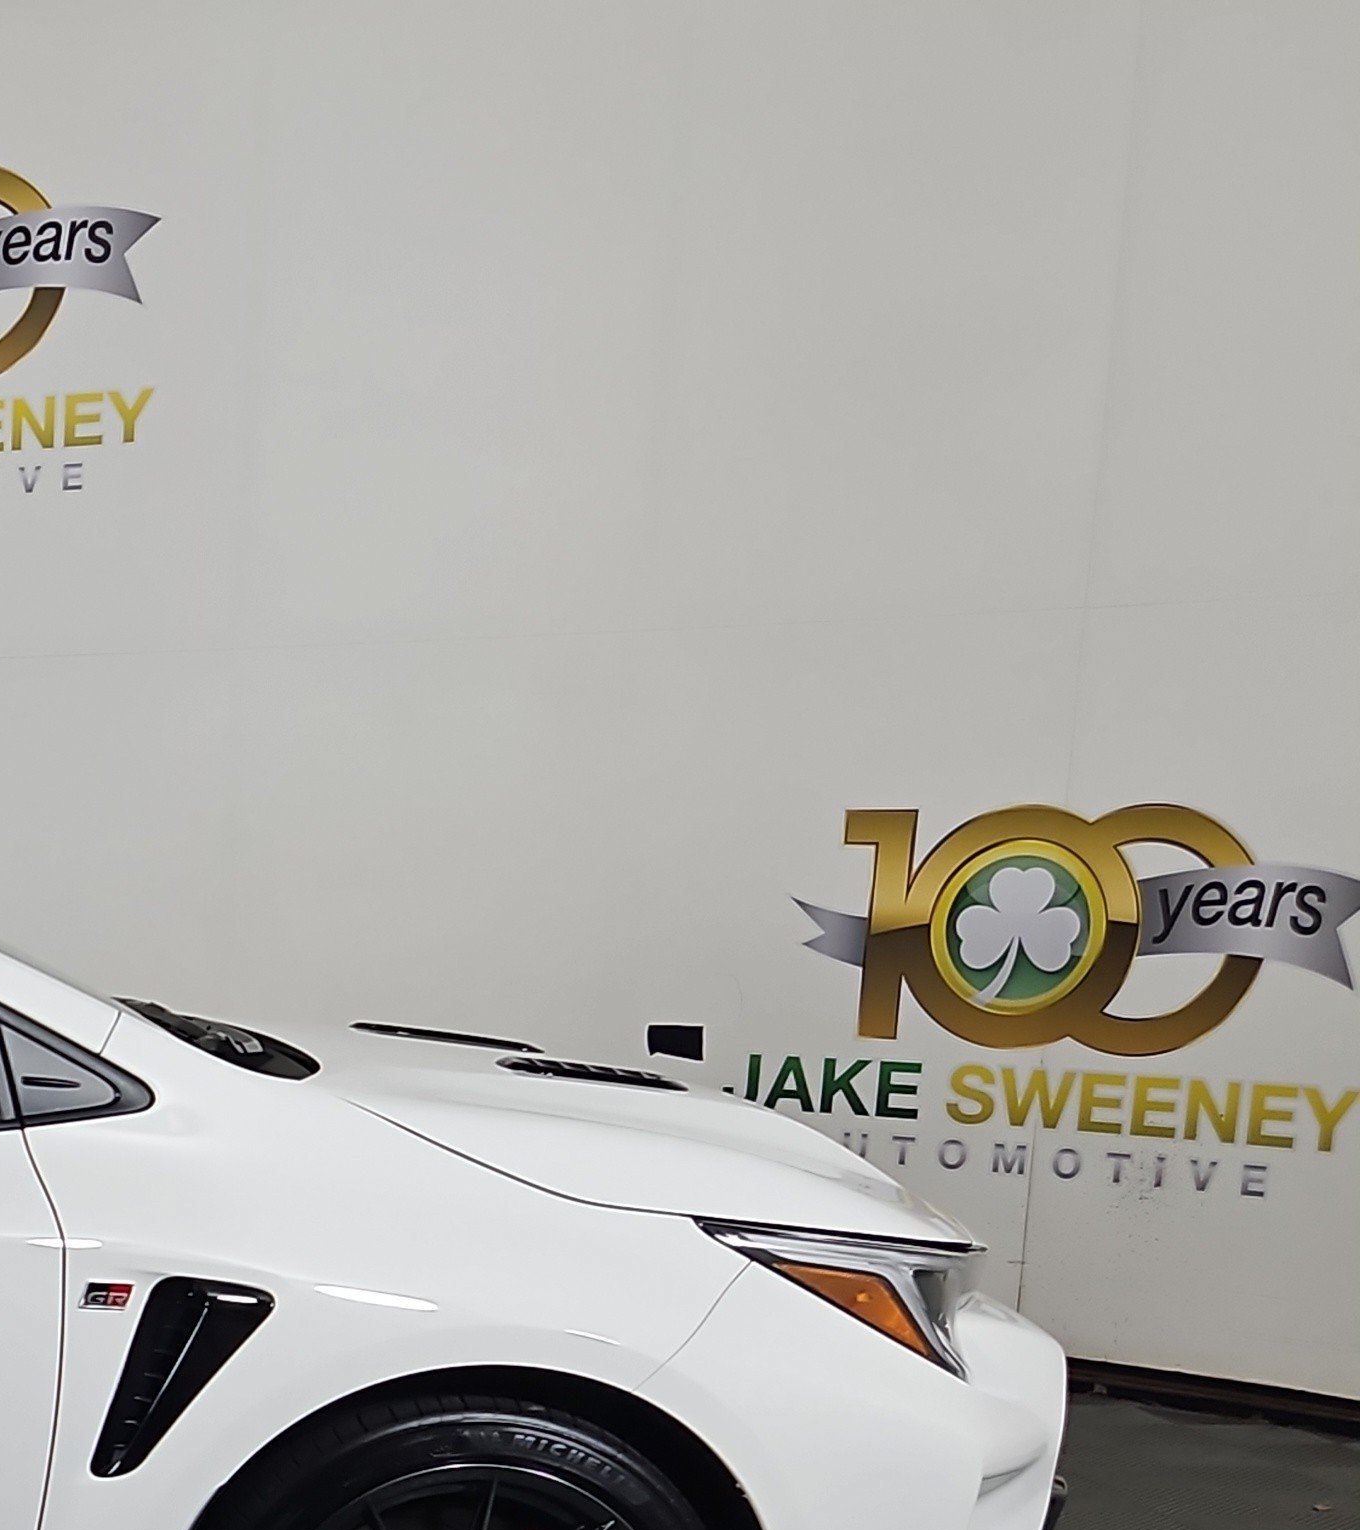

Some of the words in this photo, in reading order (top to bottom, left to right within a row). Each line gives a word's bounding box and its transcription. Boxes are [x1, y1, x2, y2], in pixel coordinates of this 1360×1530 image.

[844, 803, 1264, 1057] 100
[1152, 878, 1327, 945] years
[946, 1063, 1360, 1153] SWEENEY
